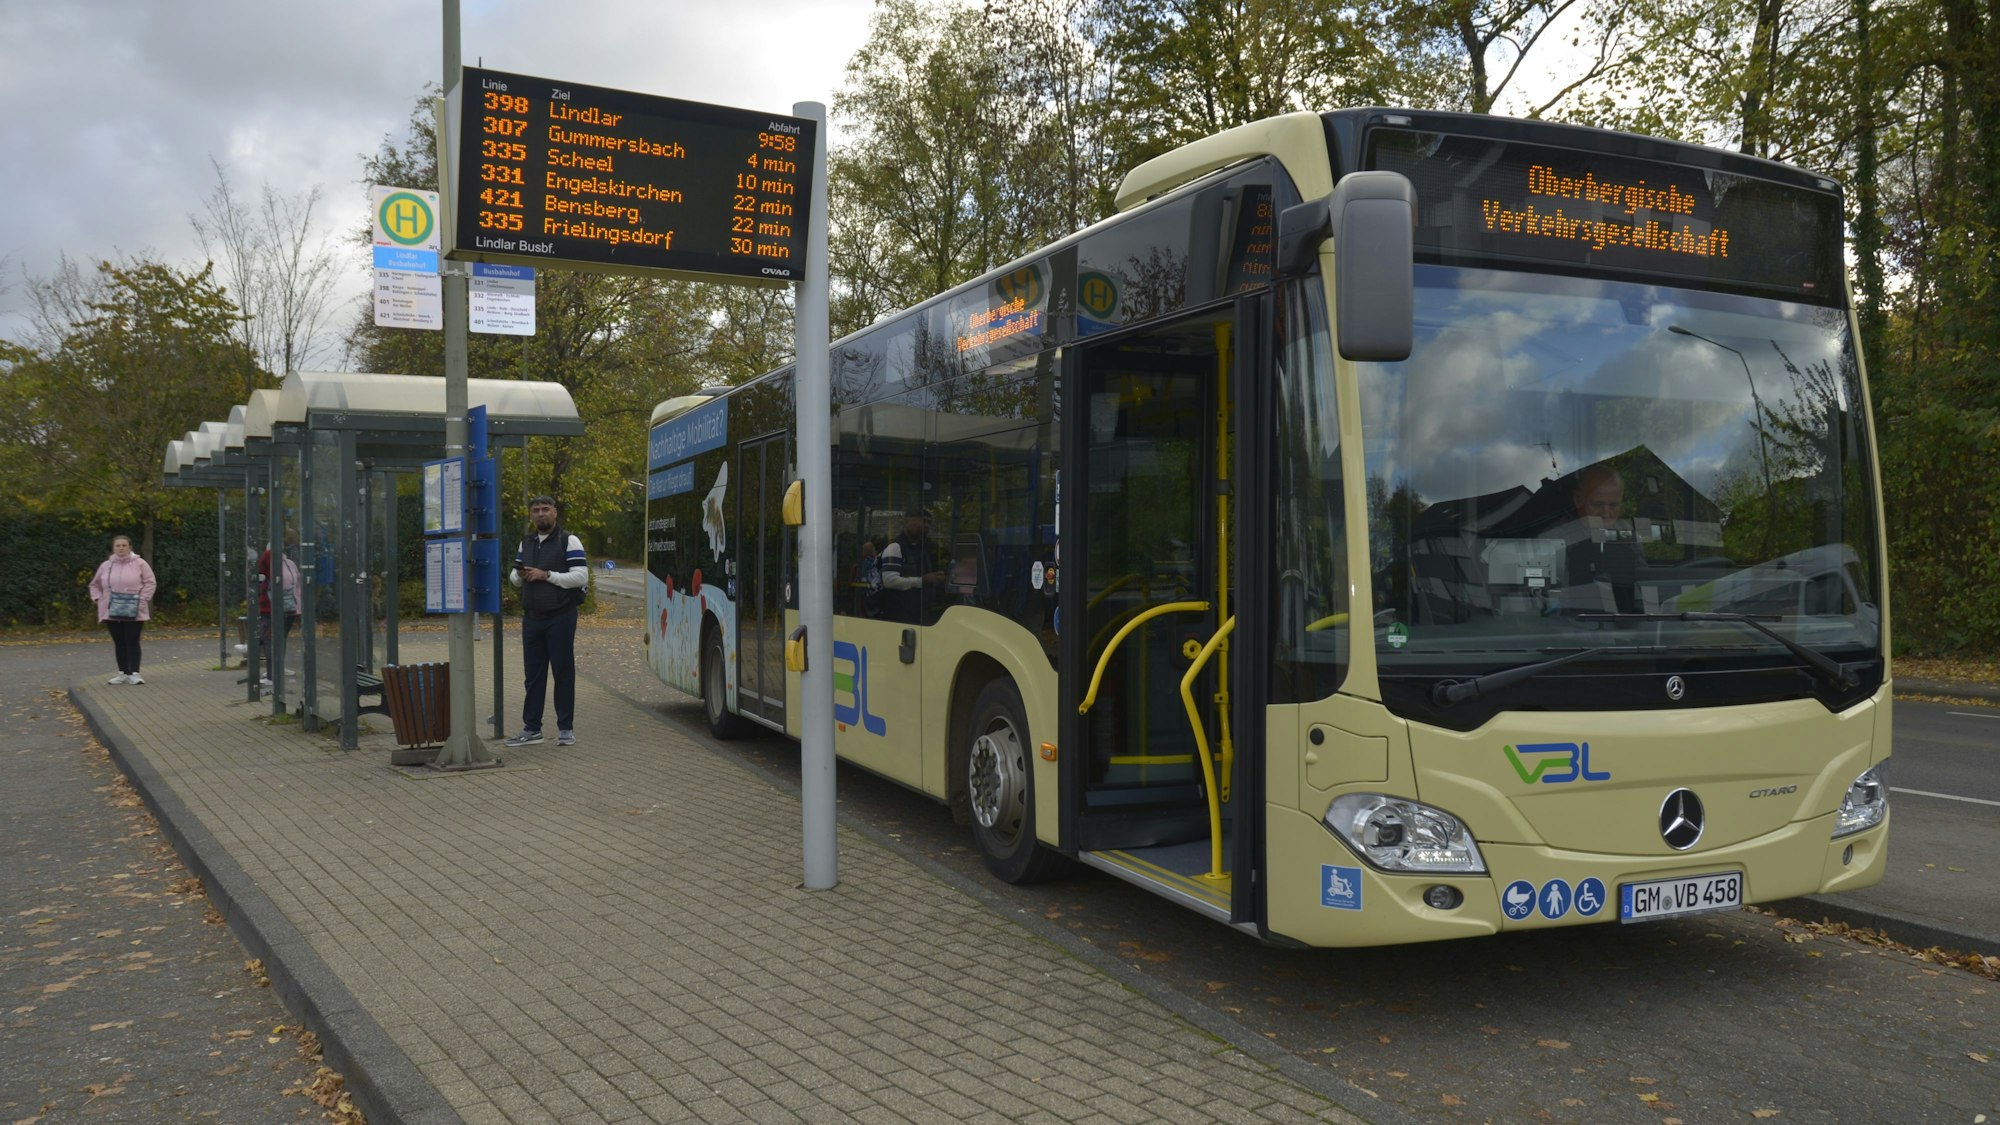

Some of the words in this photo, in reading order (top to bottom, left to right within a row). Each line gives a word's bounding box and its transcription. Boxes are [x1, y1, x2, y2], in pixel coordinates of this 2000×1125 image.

[482, 78, 508, 92] Linie
[551, 88, 571, 101] Ziel
[768, 121, 801, 135] Abfahrt
[484, 92, 529, 114] 398
[549, 101, 622, 127] Lindlar
[758, 132, 796, 152] 9:58
[482, 140, 527, 161] 335
[547, 148, 613, 172] Scheel
[736, 173, 757, 190] 10
[762, 178, 794, 195] min
[483, 116, 528, 138] 307
[548, 125, 686, 159] Gummersbach
[747, 153, 758, 169] 4
[763, 157, 796, 174] min
[480, 188, 524, 208] 421
[545, 195, 639, 224] Bensberg
[732, 216, 754, 233] 22
[758, 220, 791, 237] min
[481, 163, 525, 185] 331
[546, 171, 683, 203] Engelskirchen
[733, 194, 755, 212] 22
[760, 199, 793, 216] min
[1528, 164, 1696, 215] Oberbergische
[396, 203, 418, 234] H
[479, 211, 524, 232] 335
[543, 217, 674, 250] Frielingsdorf
[730, 237, 752, 254] 30
[757, 242, 789, 258] min
[1483, 199, 1729, 258] Verkehrsgesellschaft
[475, 235, 516, 250] Lindlar
[519, 239, 555, 255] Busbf.
[483, 267, 520, 277] Busbahnhof
[761, 267, 790, 277] OVAG
[687, 409, 724, 448] Mobilität?
[833, 640, 887, 737] BL
[1503, 741, 1611, 785] VBL
[1749, 785, 1797, 798] CITARO
[1624, 905, 1630, 913] D
[1634, 886, 1660, 913] GM
[1674, 882, 1698, 908] VB
[1703, 878, 1738, 904] 458
